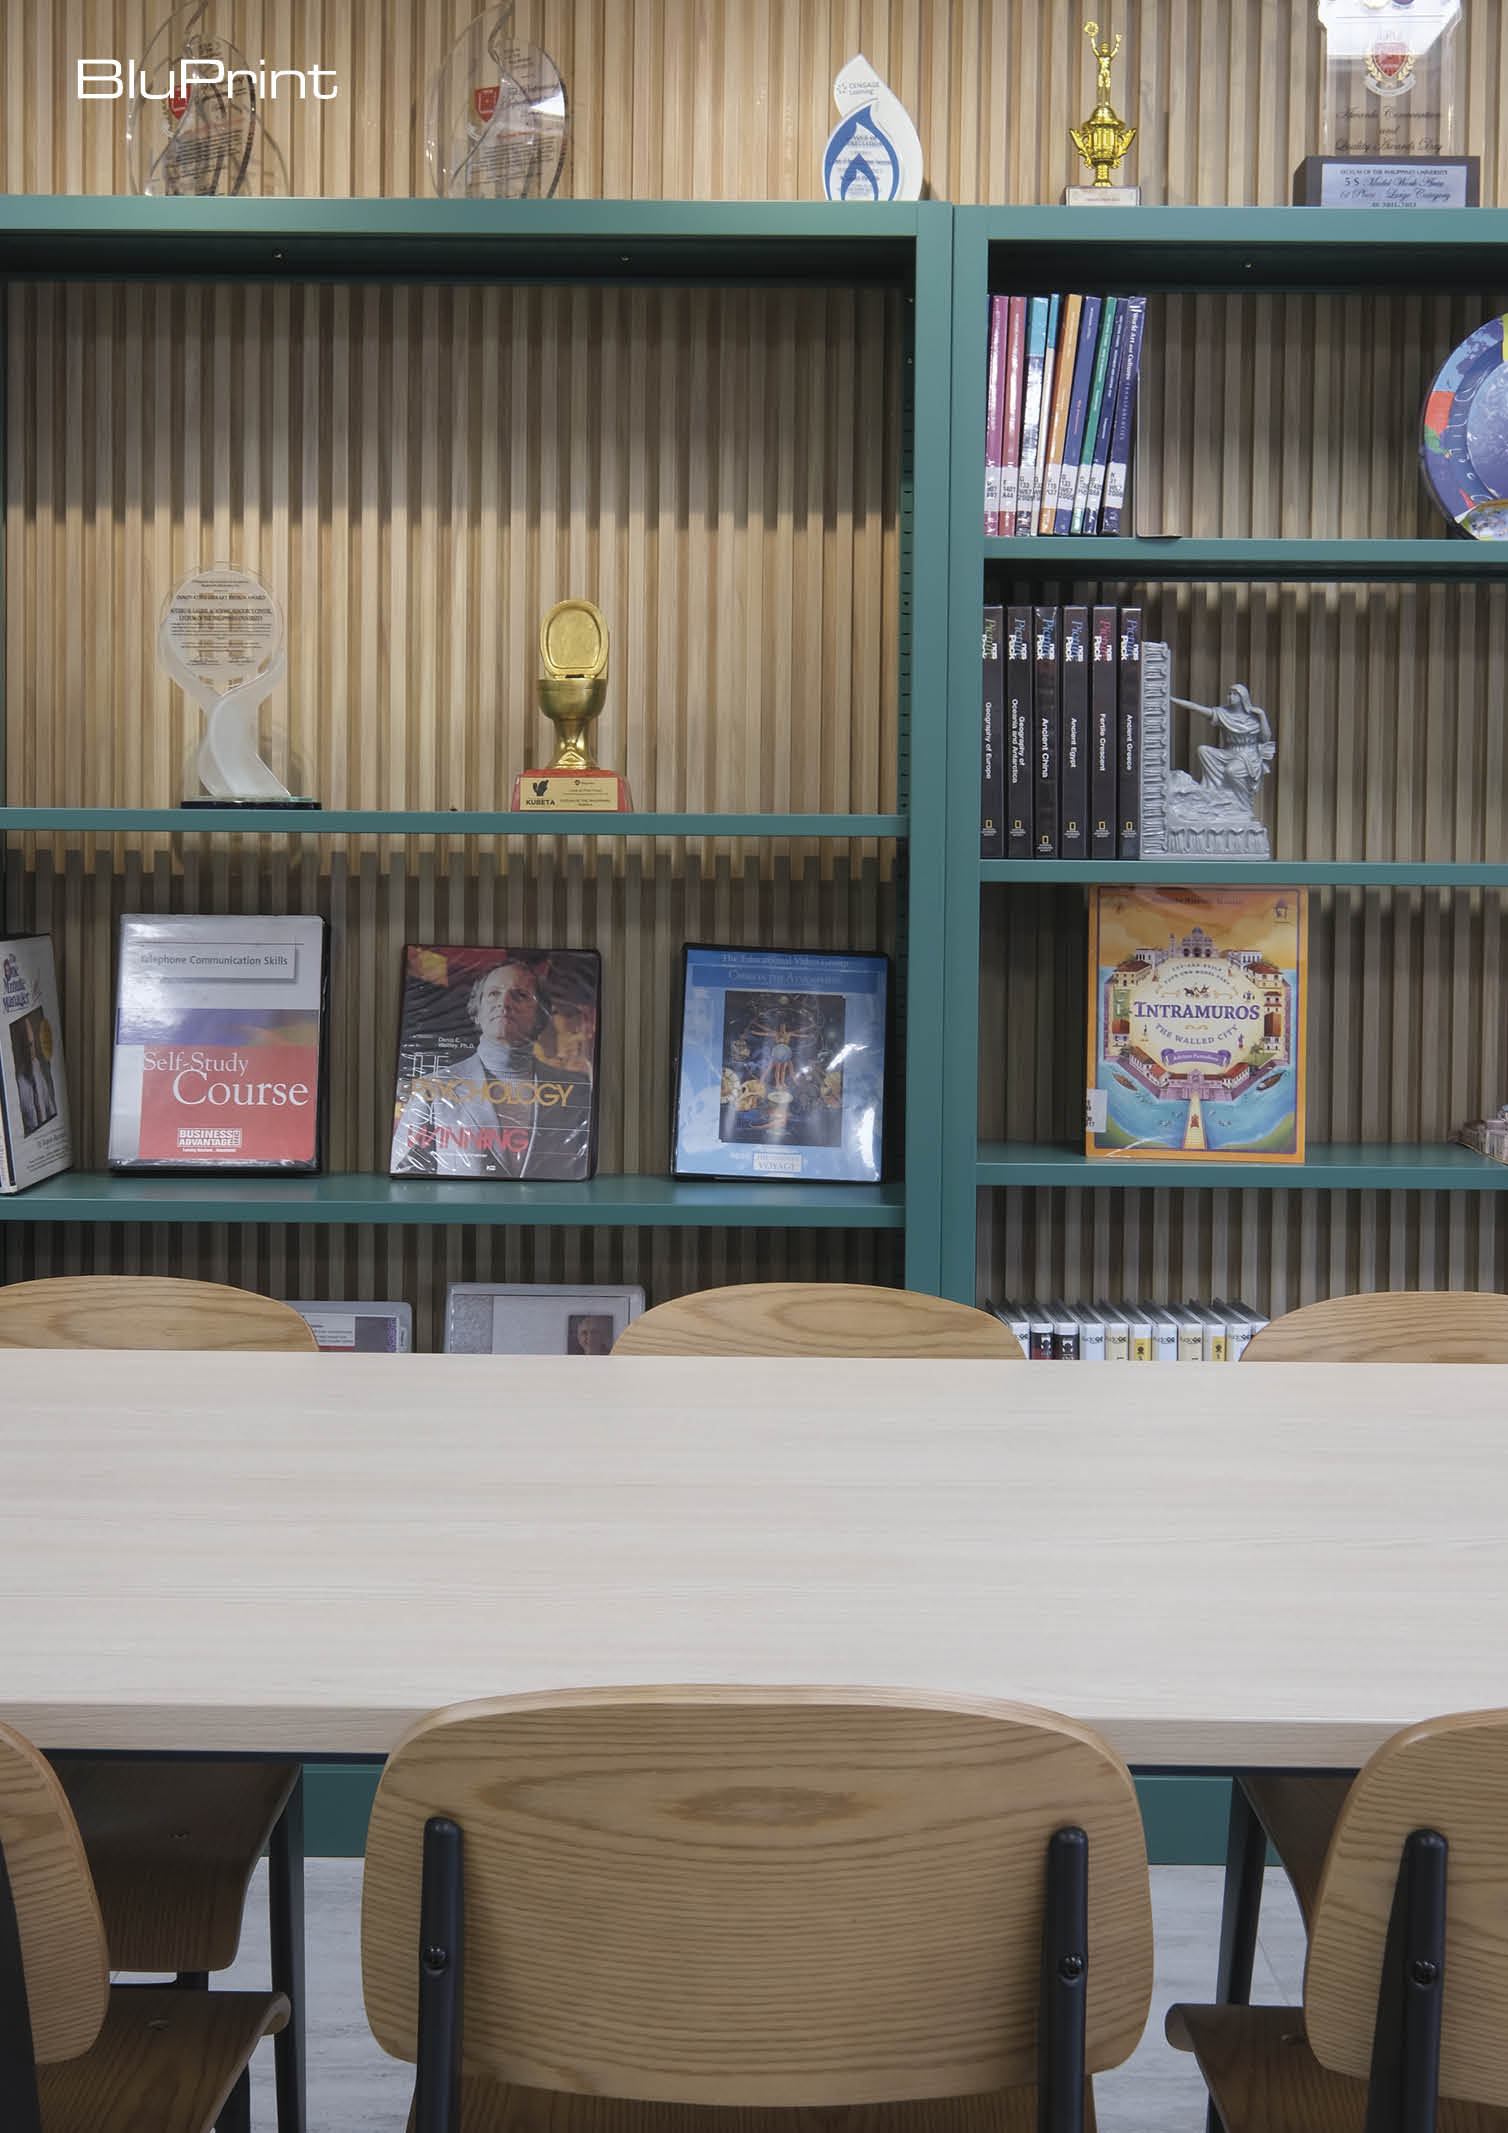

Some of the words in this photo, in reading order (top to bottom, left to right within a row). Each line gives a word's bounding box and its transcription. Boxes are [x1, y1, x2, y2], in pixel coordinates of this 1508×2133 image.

[1008, 634, 1016, 661] Pack
[1036, 634, 1045, 661] Pack
[1065, 636, 1073, 662] Pack
[1093, 635, 1102, 662] Pack
[984, 702, 992, 742] Geography
[1126, 714, 1134, 742] Ancient
[985, 743, 992, 752] of
[1018, 716, 1026, 757] Geography
[1042, 753, 1050, 779] China
[1069, 747, 1078, 769] Egypt
[1126, 743, 1134, 772] Greece
[190, 955, 262, 966] Communication
[264, 956, 289, 966] Skills
[1134, 1000, 1261, 1021] INTRAMUROS
[1155, 1023, 1173, 1039] THE
[1175, 1034, 1215, 1045] WALLED
[1217, 1023, 1239, 1041] CITY
[143, 1051, 249, 1077] Self-Study
[173, 1069, 309, 1106] Course
[411, 1078, 575, 1108] PSYCHOLOGY
[179, 1138, 233, 1146] ADVANTAGE
[180, 1130, 233, 1139] BUSINESS
[407, 1125, 529, 1153] WINNING
